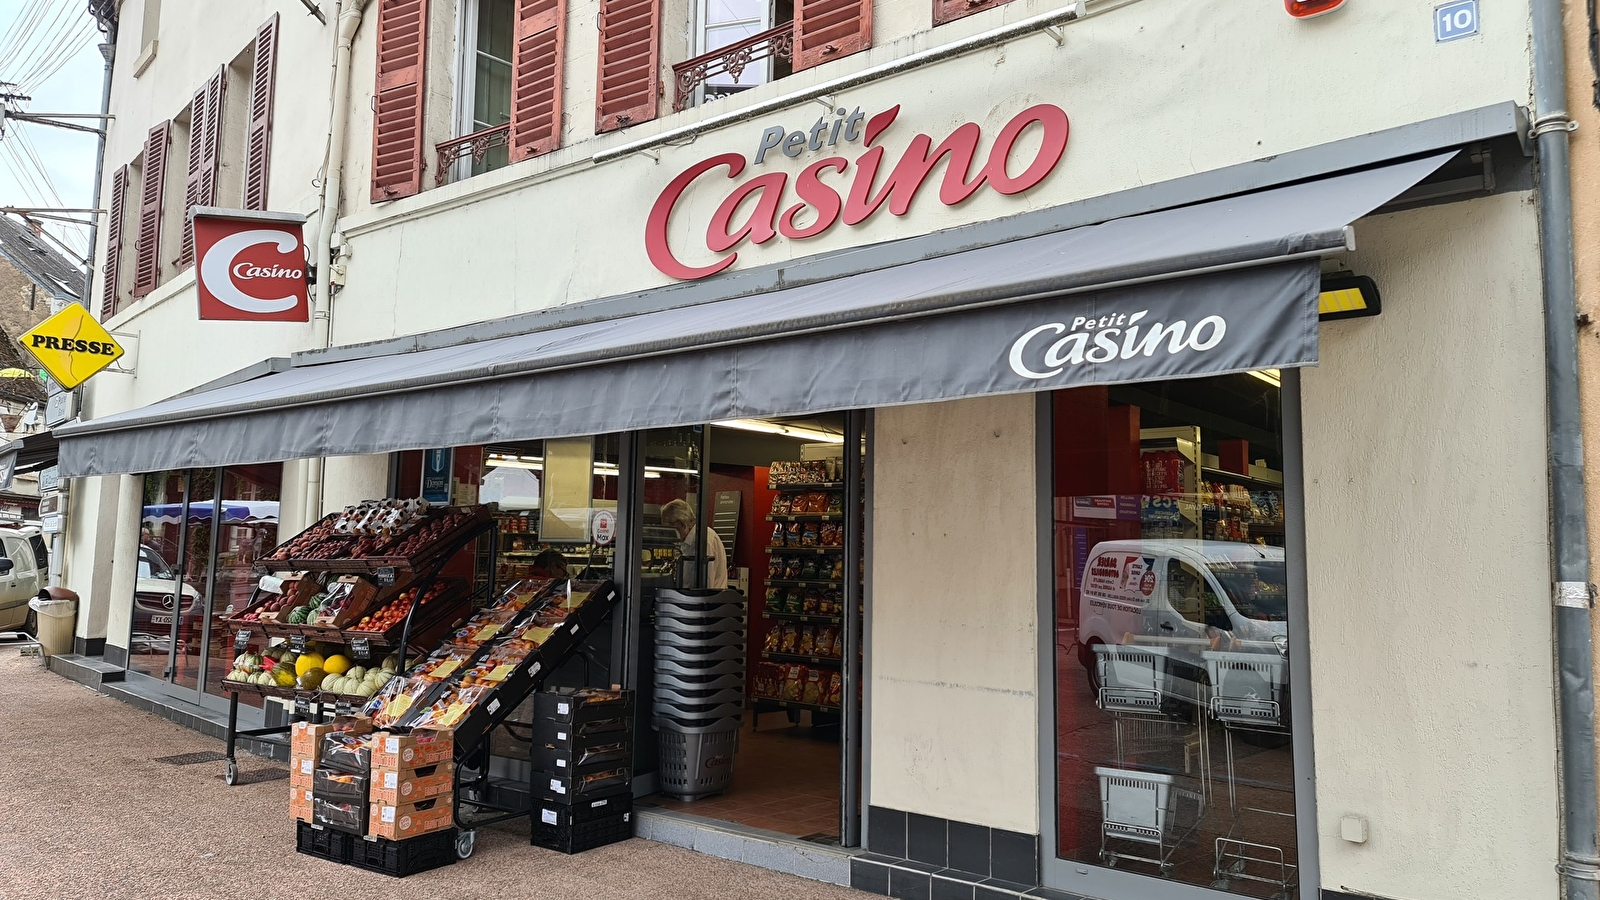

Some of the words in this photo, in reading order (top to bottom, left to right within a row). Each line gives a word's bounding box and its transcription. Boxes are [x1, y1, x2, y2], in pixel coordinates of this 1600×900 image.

[1442, 9, 1472, 33] 10
[754, 105, 865, 165] Petit
[644, 103, 1070, 281] Casino
[232, 262, 303, 281] Casino
[1070, 312, 1127, 332] Petit
[31, 334, 115, 357] PRESSE
[1009, 309, 1227, 380] Casino
[596, 533, 610, 541] Max
